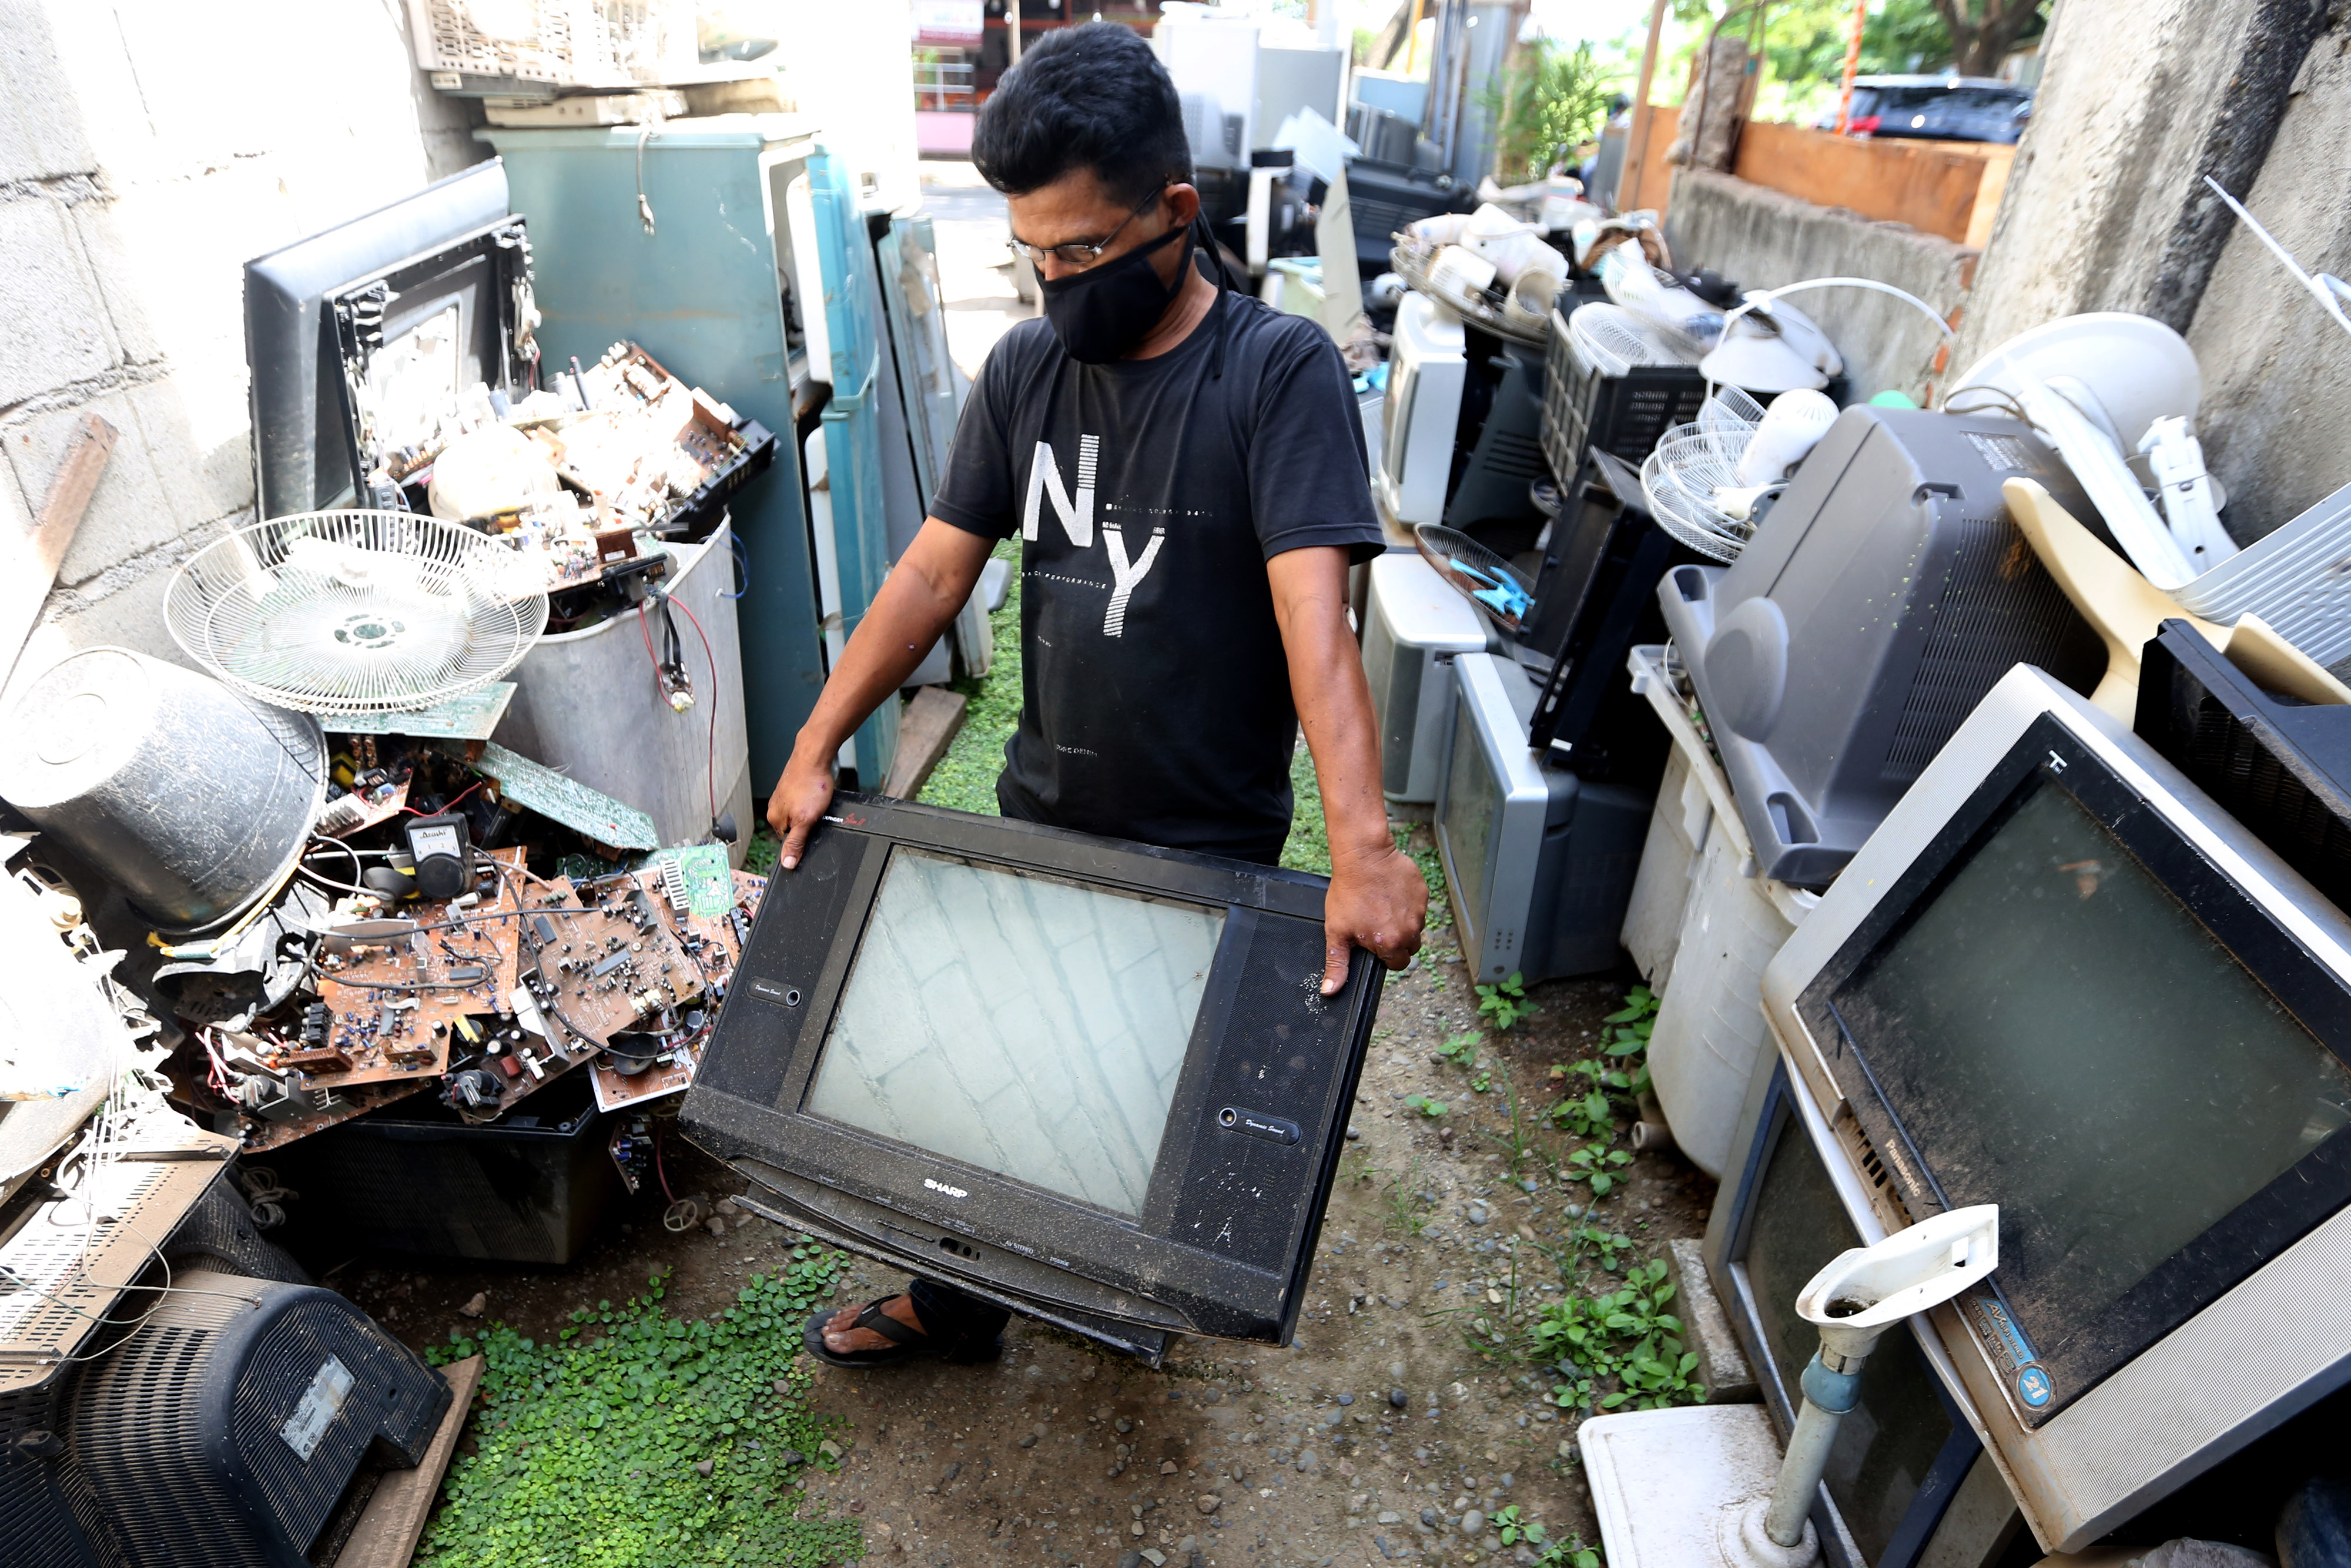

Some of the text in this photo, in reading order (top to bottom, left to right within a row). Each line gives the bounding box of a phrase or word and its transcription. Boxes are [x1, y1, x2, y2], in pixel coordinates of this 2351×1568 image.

[1023, 434, 1100, 548] N
[1103, 527, 1166, 638] Y
[1245, 1118, 1285, 1134] Dynamic Sound
[1885, 1139, 1921, 1197] Panasonic
[923, 1178, 969, 1199] SHARP
[1986, 1302, 2008, 1322] AV
[2023, 1375, 2048, 1399] 21
